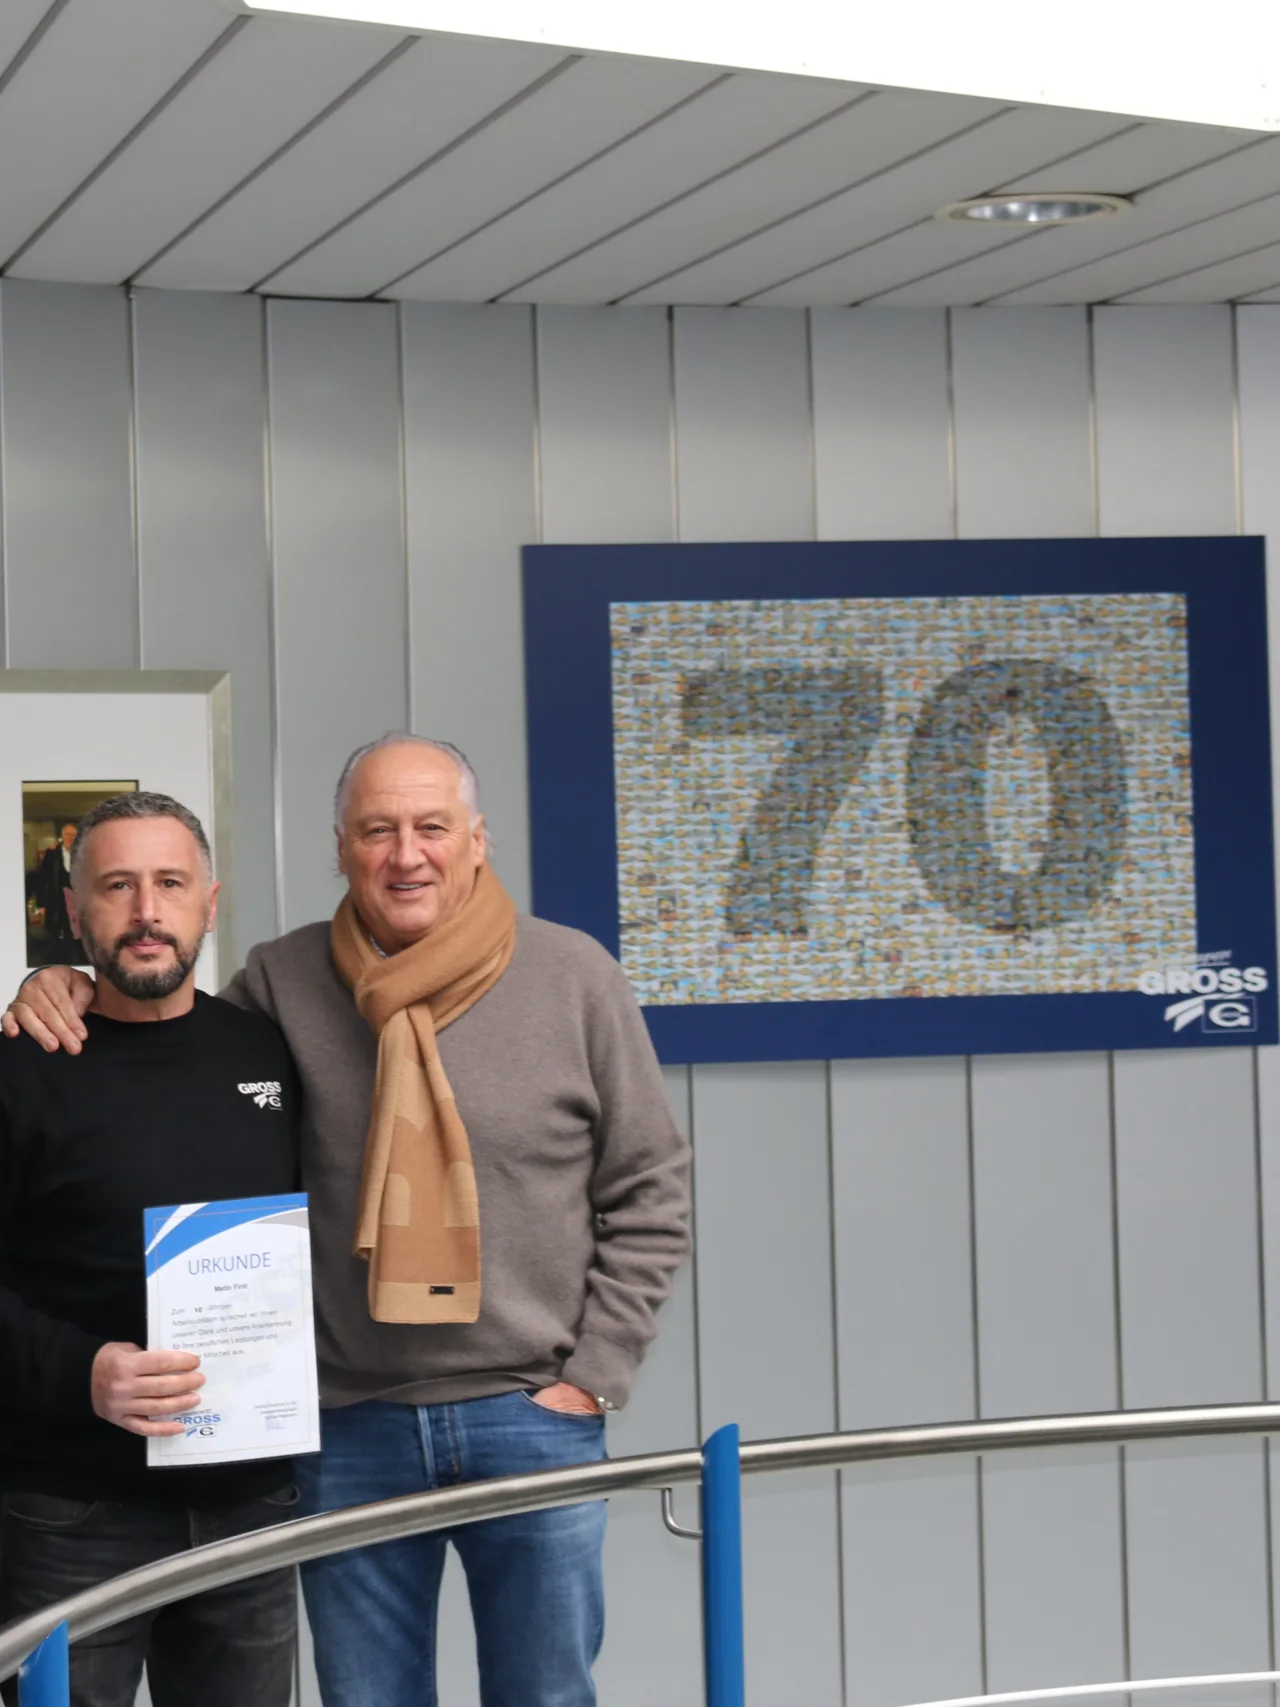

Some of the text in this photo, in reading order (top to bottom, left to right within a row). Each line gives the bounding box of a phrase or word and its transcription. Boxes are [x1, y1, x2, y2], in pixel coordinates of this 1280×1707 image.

[680, 657, 1127, 938] 70
[1138, 966, 1268, 996] GROSS
[237, 1081, 282, 1094] GROSS
[188, 1252, 271, 1275] URKUNDE
